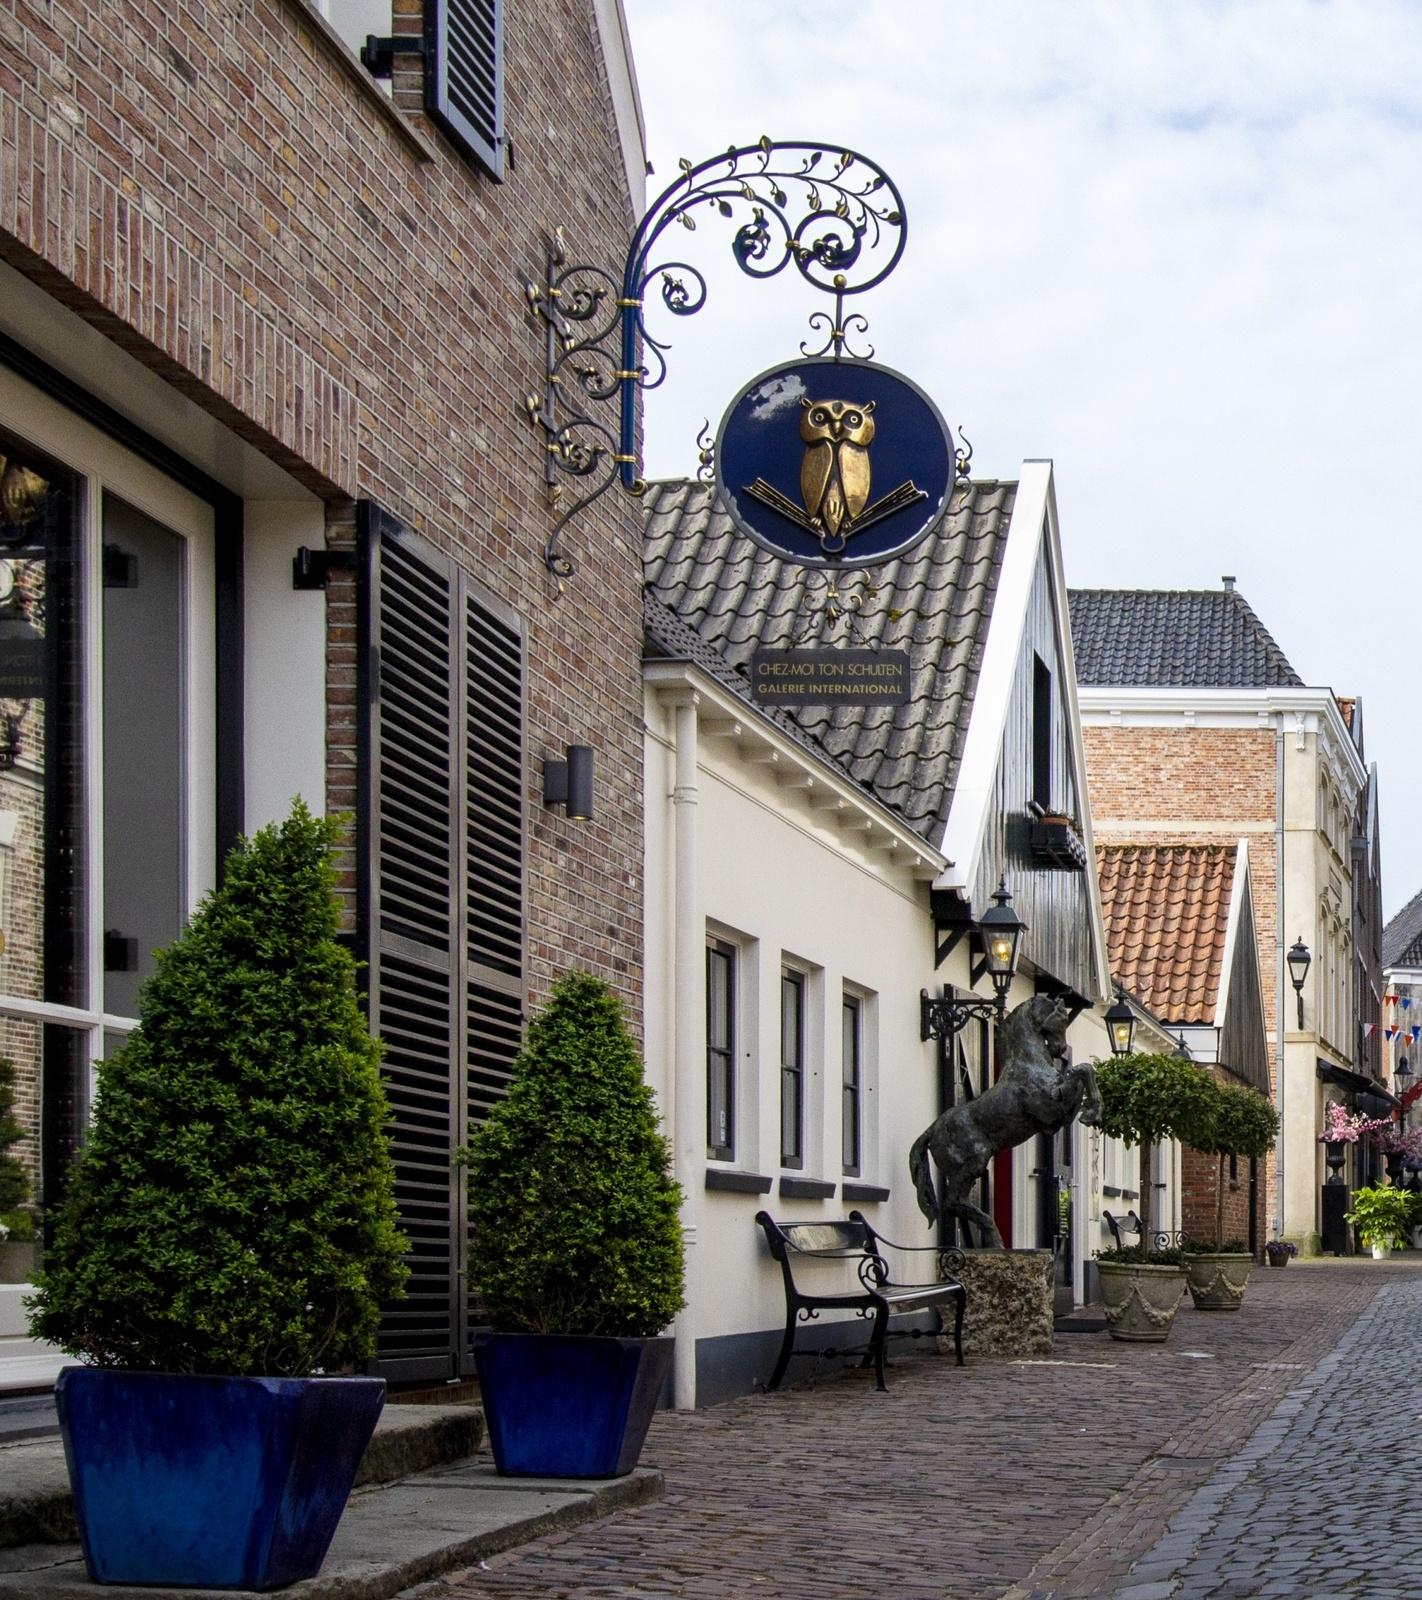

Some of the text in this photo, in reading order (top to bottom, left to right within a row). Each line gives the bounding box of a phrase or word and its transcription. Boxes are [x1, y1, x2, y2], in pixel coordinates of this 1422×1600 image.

[819, 663, 844, 676] TON
[847, 663, 902, 676] SCHULTEN
[758, 683, 902, 694] GALERIE INTERNATIONAL
